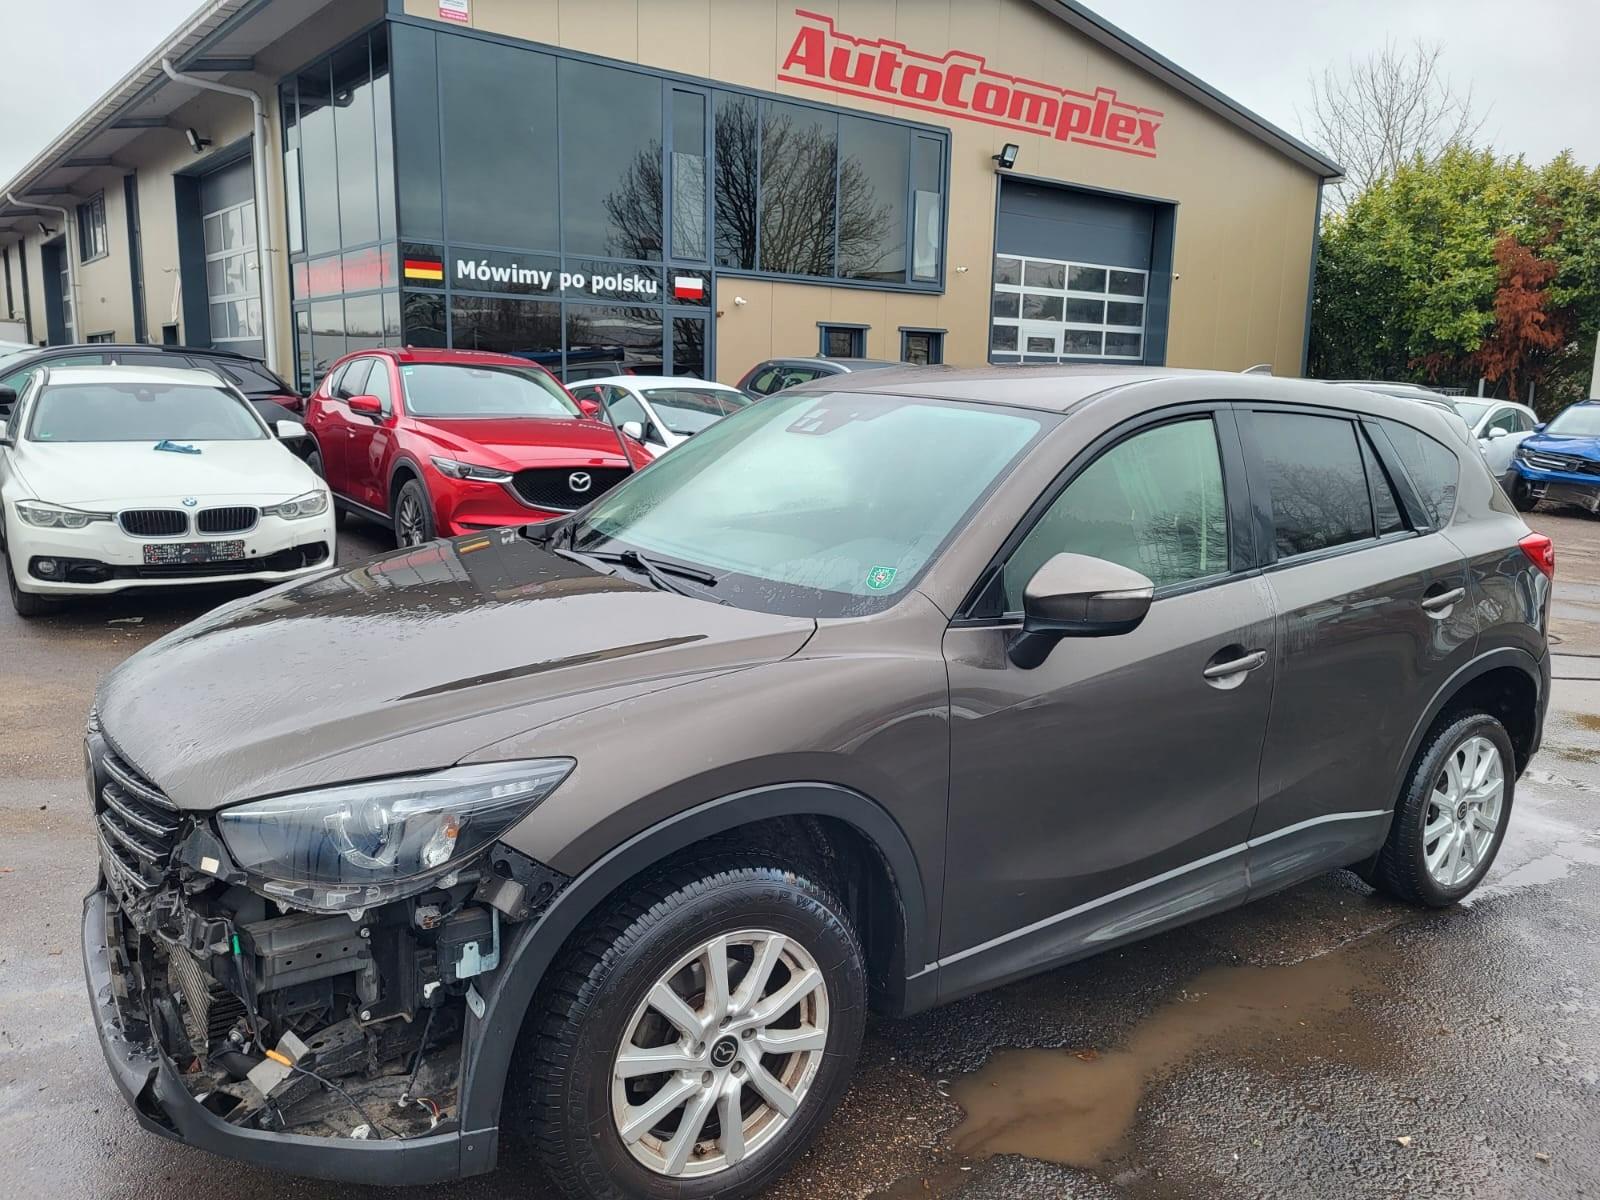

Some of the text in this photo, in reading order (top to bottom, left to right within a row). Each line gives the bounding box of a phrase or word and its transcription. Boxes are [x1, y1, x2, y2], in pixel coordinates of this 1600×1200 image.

[782, 26, 1162, 150] AutoComplex
[456, 259, 658, 295] Mówimy po polsku
